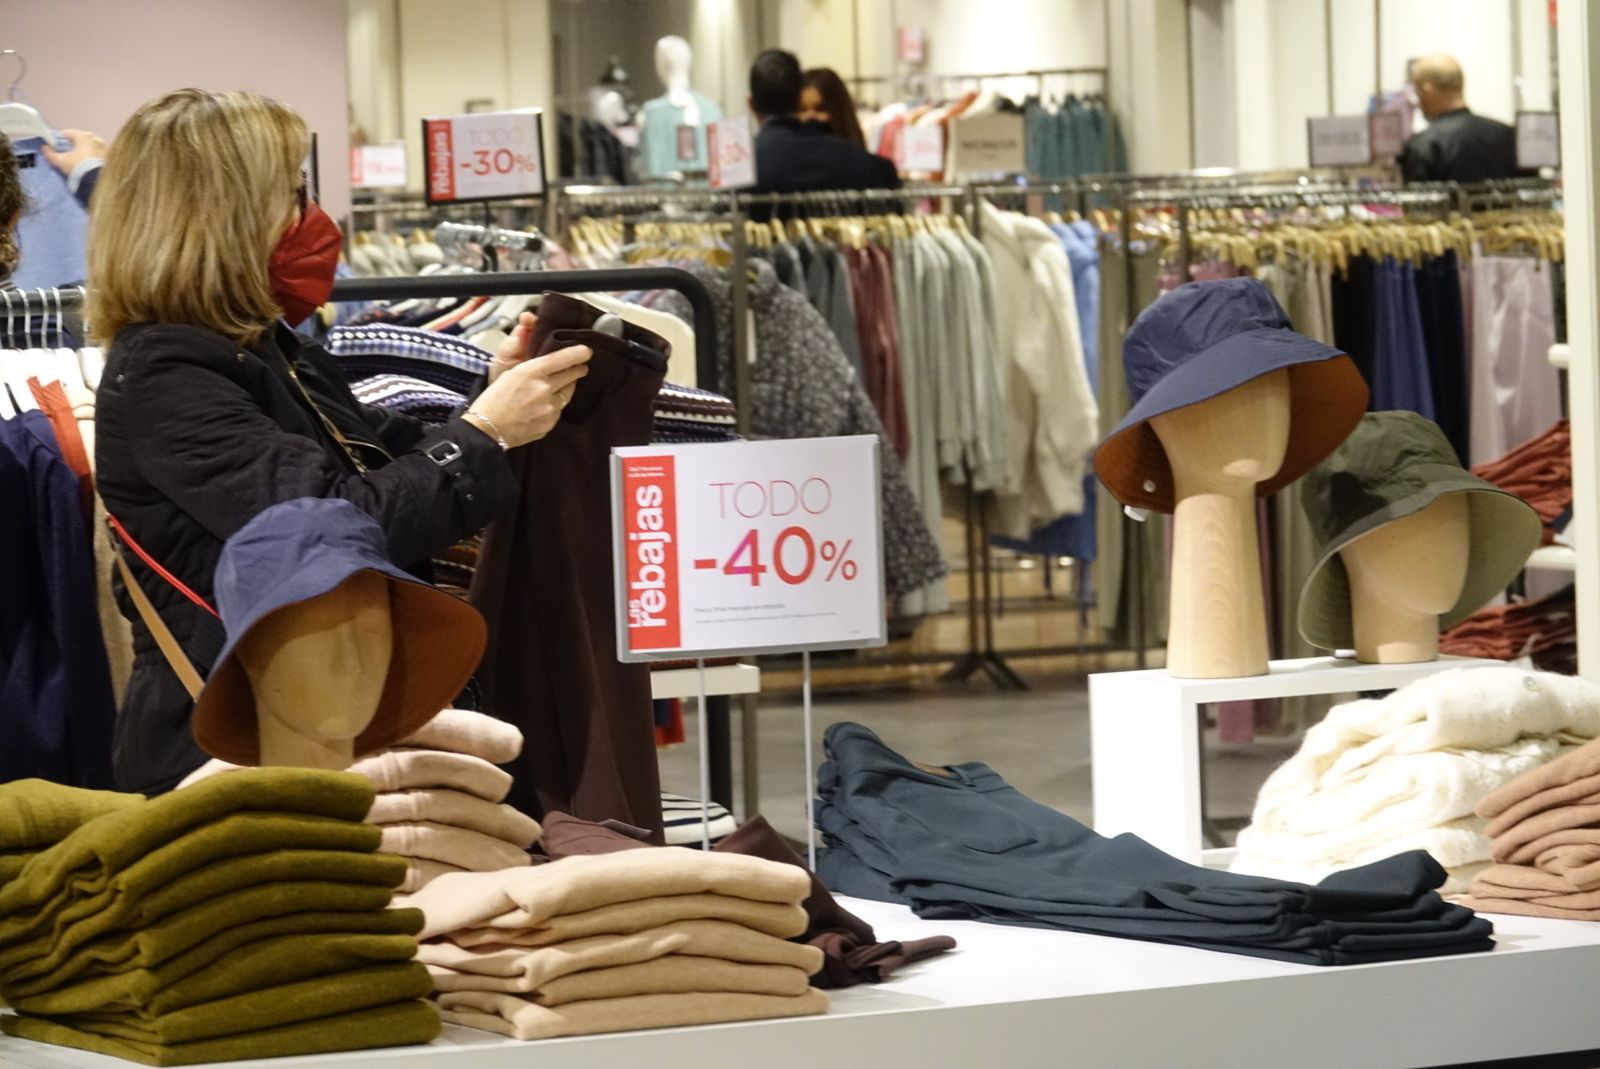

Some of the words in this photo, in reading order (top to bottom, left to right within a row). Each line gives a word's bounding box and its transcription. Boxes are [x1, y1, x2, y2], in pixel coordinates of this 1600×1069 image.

[461, 148, 535, 176] -30%
[709, 477, 831, 519] TODO
[630, 484, 671, 627] rebajas
[694, 526, 857, 586] -40%
